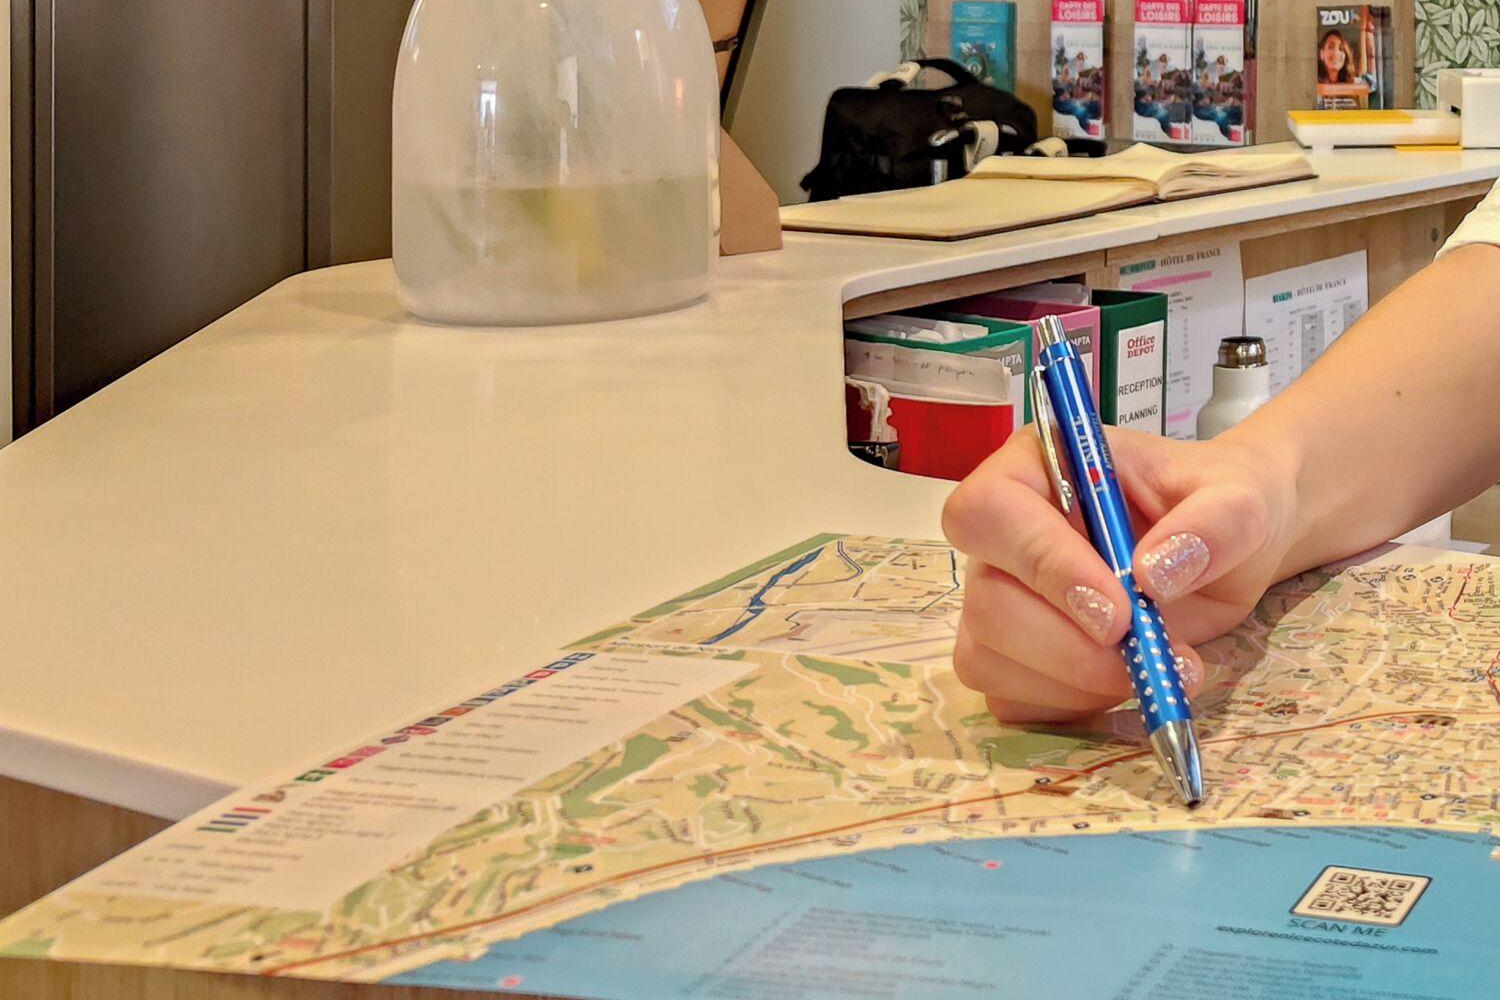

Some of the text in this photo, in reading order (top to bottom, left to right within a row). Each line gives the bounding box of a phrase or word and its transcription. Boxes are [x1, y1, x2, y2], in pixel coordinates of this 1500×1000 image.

[1058, 11, 1098, 22] LOISIRS
[1140, 12, 1181, 23] LOISIRS
[1198, 13, 1238, 24] LOISIRS
[1126, 334, 1156, 351] Office
[1127, 344, 1156, 360] DEPOT
[1118, 375, 1163, 397] RECEPTION
[1118, 404, 1159, 426] PLANNING
[1286, 917, 1391, 937] SCAN ME
